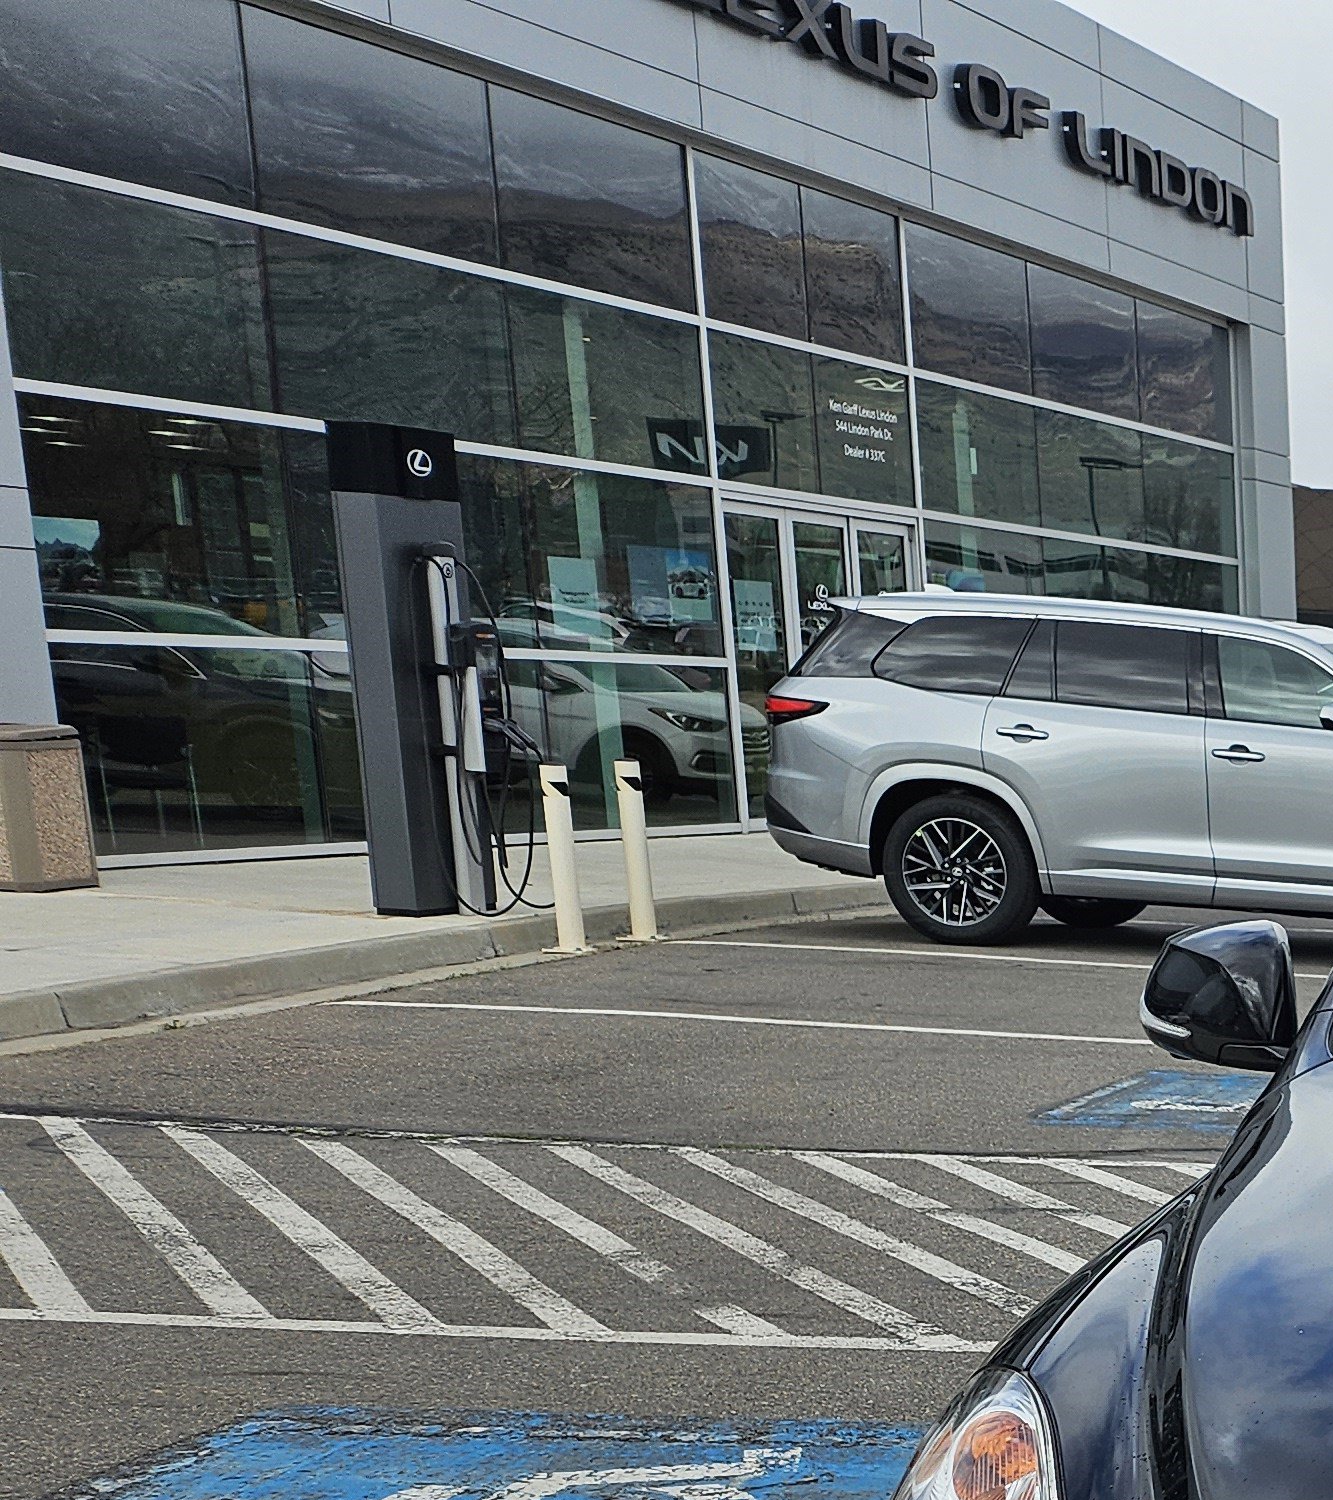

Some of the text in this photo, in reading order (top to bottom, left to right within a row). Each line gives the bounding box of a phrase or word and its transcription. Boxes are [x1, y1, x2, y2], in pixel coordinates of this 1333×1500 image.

[695, 0, 938, 99] EXUS
[954, 63, 1050, 139] OF
[829, 399, 842, 412] Ken
[859, 405, 876, 420] Lexus
[877, 410, 897, 423] Lindon
[836, 420, 847, 432] 544
[848, 422, 869, 436] Lindon
[870, 426, 883, 439] Park
[844, 443, 864, 459] Dealer
[807, 600, 835, 613] LEX
